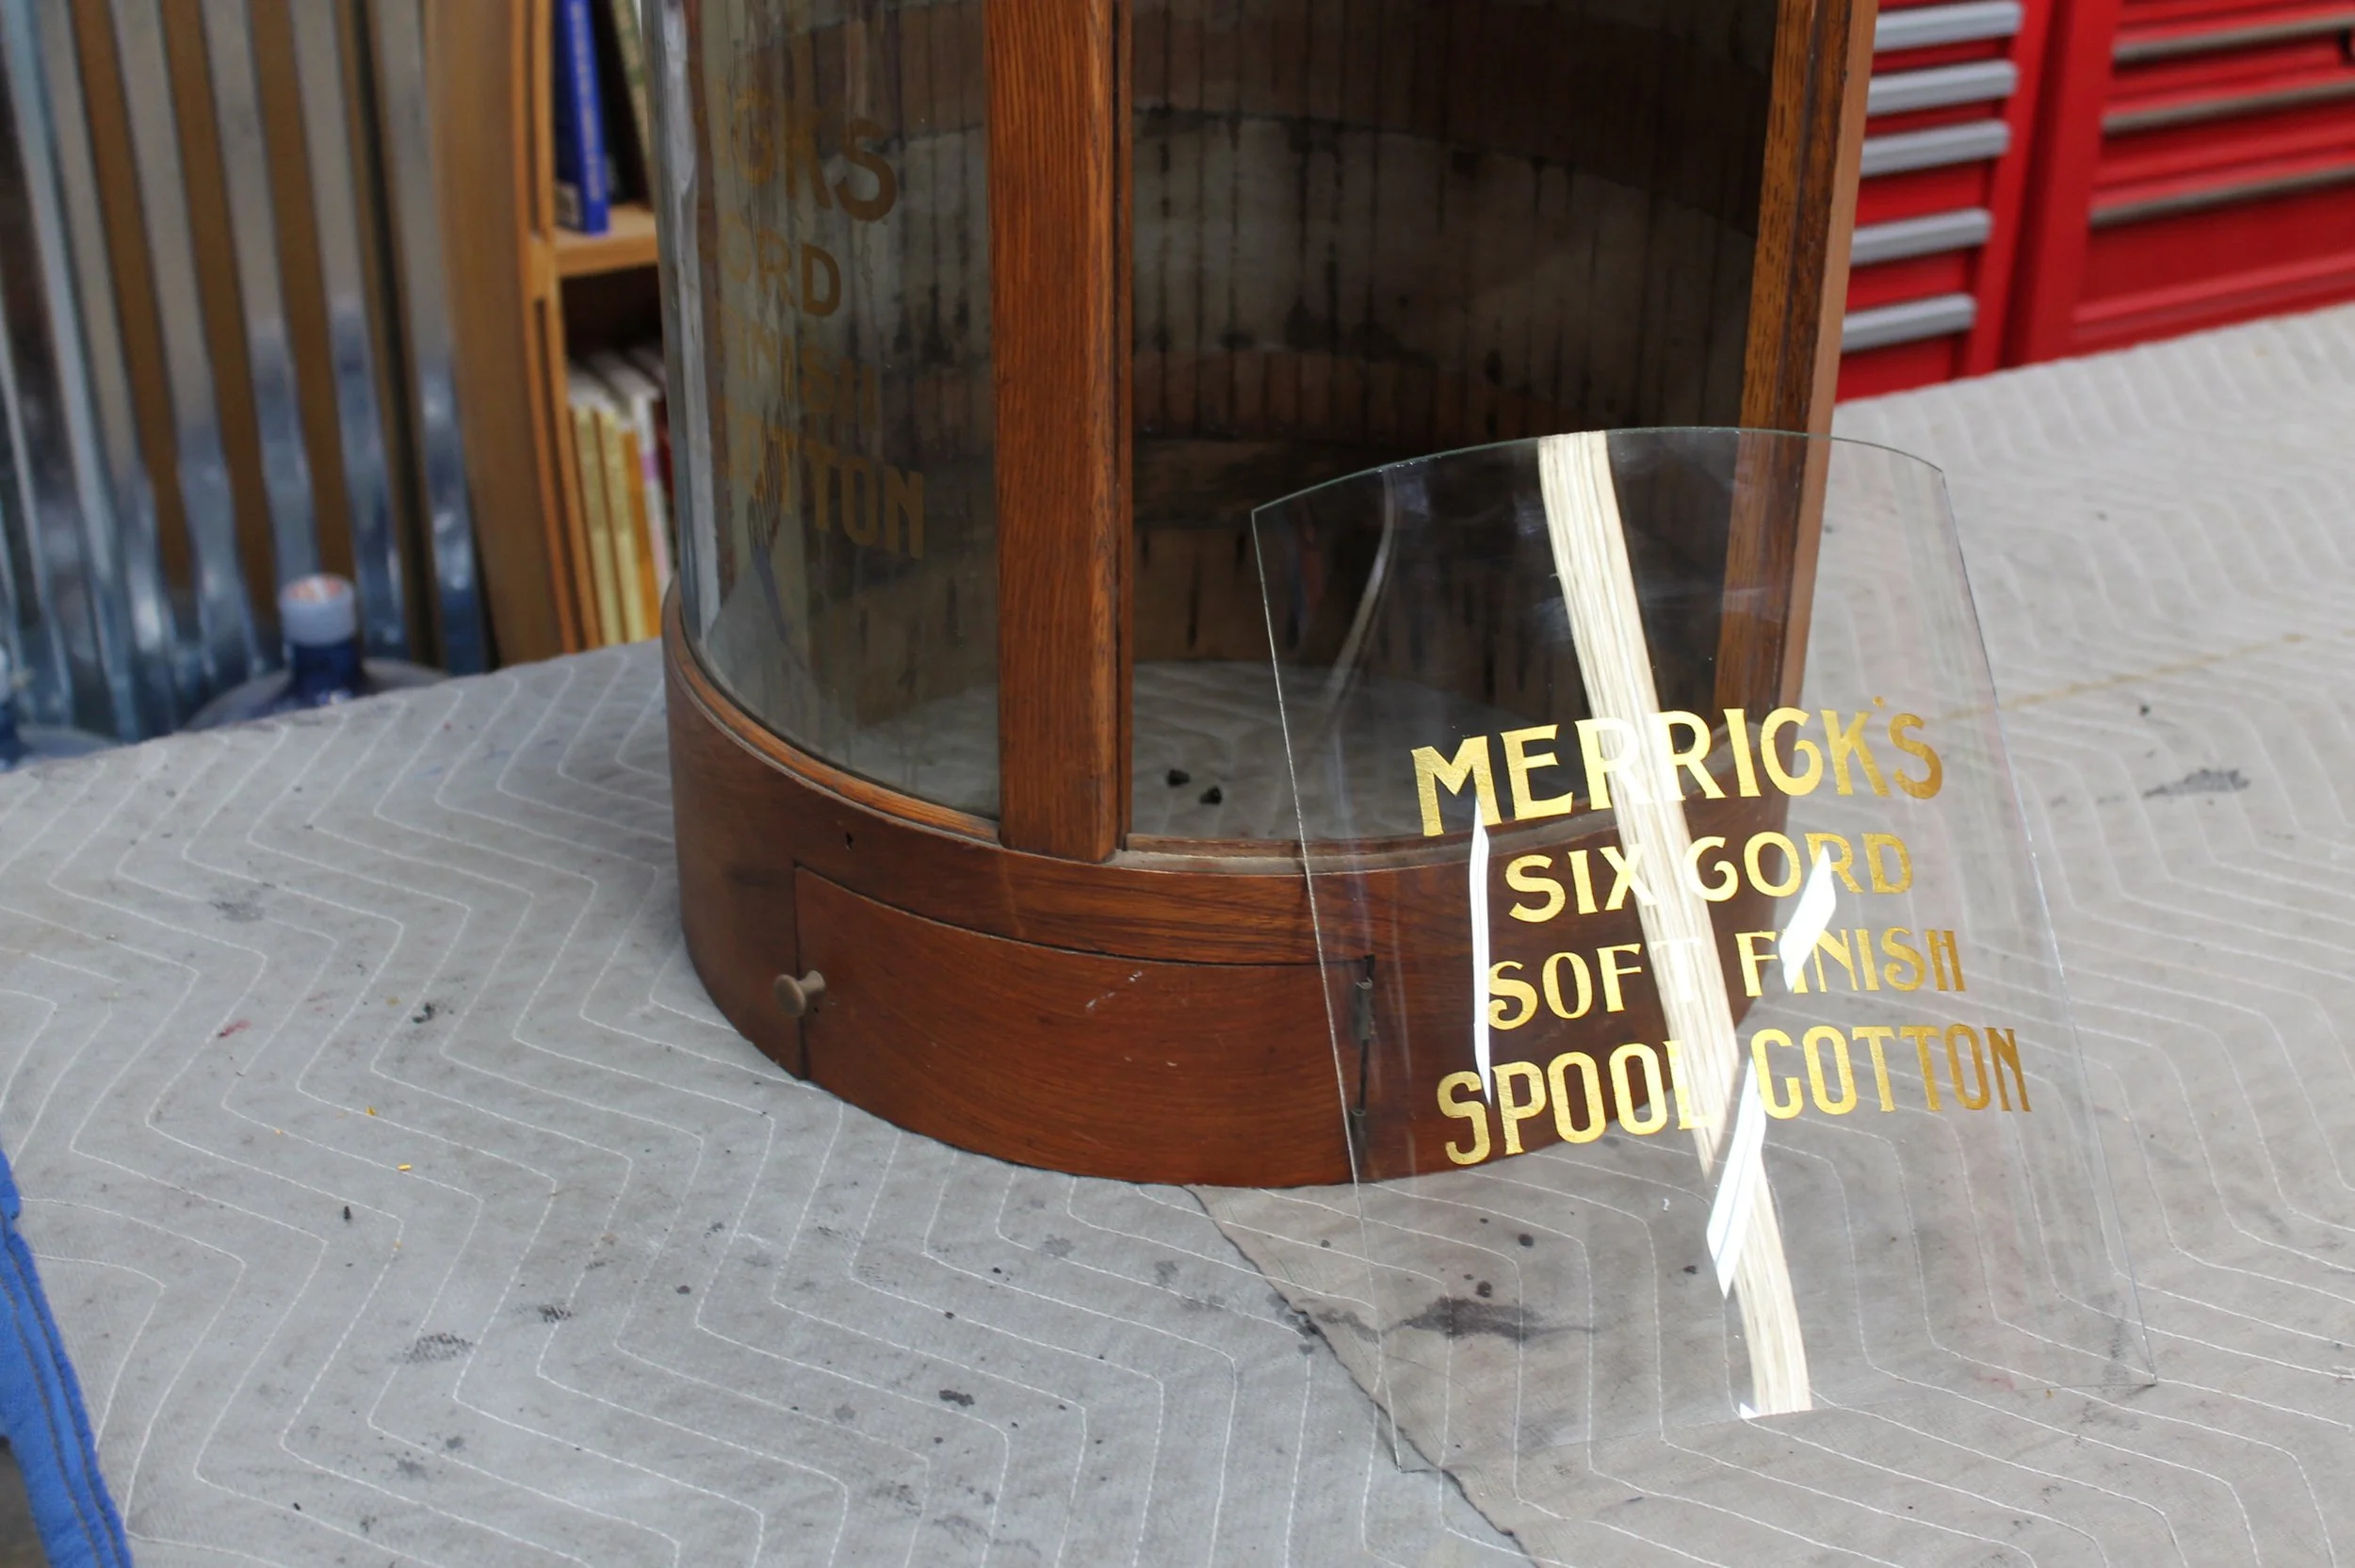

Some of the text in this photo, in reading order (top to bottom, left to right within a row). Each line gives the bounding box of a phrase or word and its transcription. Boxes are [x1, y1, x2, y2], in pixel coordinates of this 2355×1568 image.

[1504, 843, 1659, 923] SIX
[1486, 936, 1703, 1031] SOFT
[1436, 1023, 2033, 1166] SPOOL COTTON
